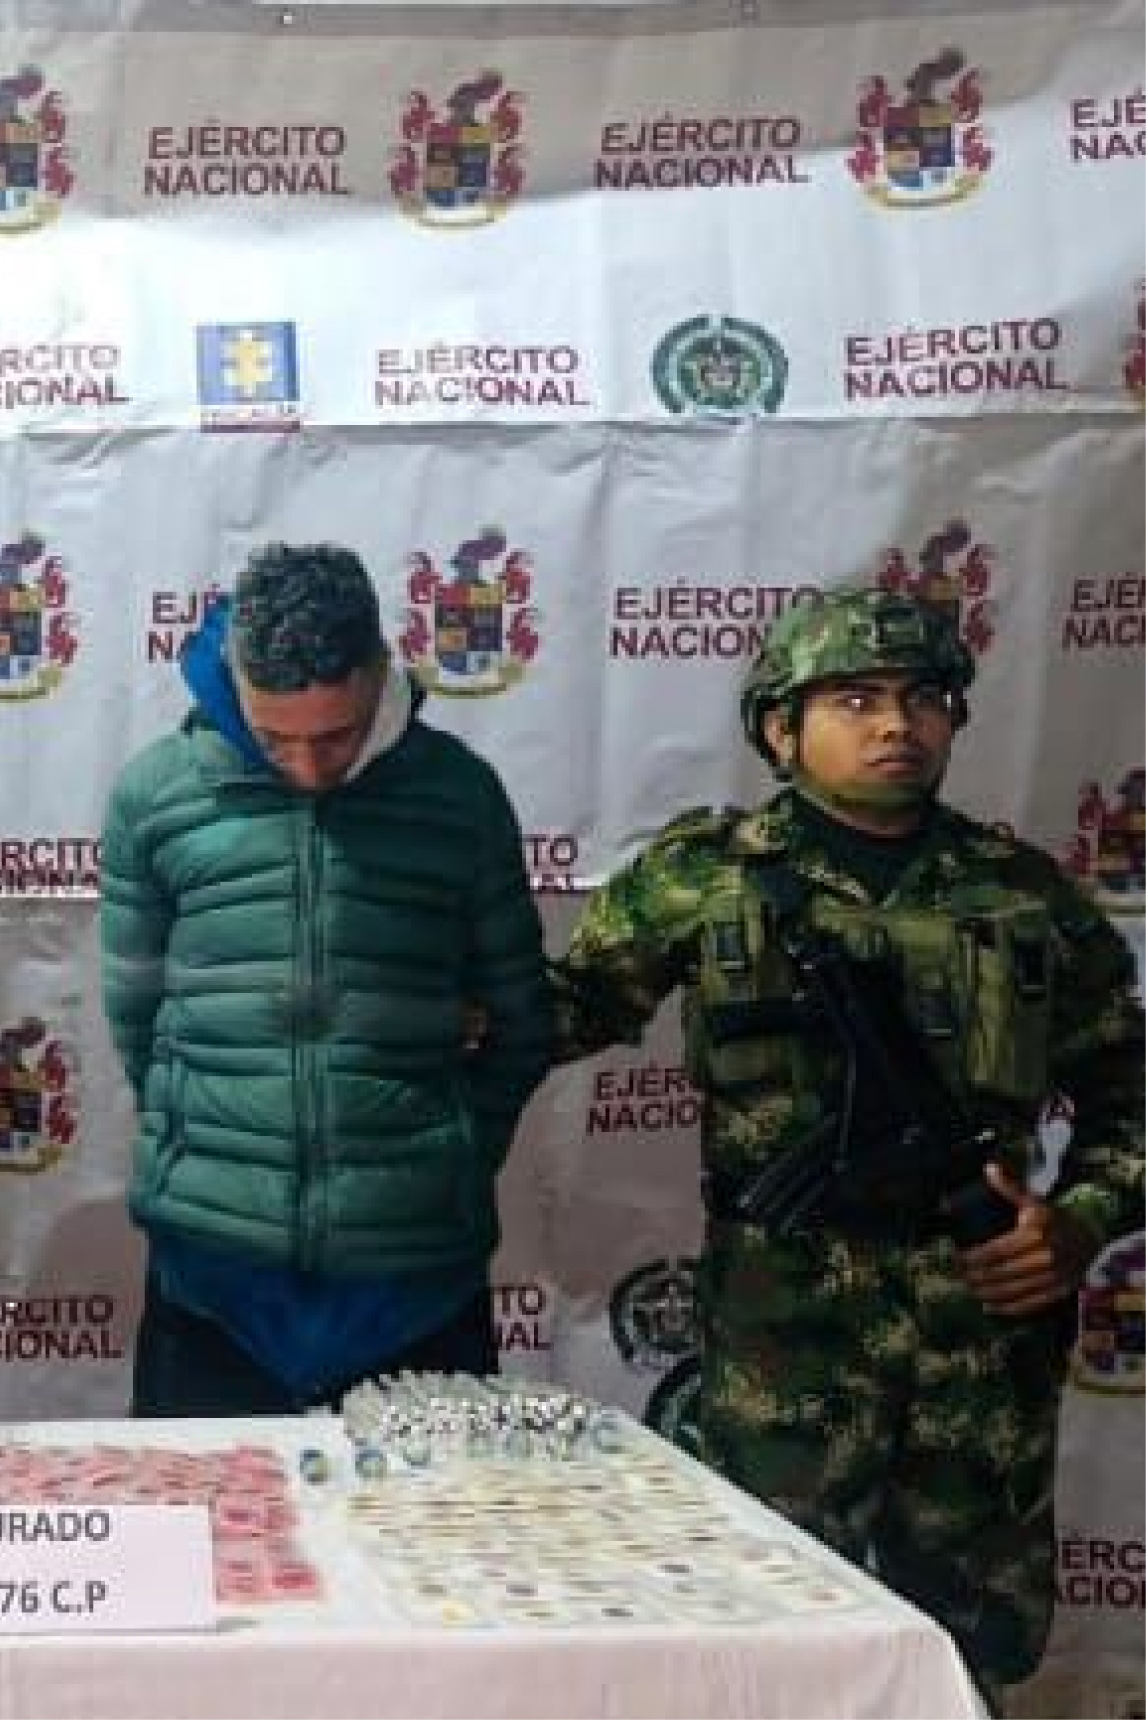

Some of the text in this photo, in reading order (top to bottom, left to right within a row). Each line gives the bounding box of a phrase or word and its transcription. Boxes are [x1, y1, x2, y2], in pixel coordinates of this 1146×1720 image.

[149, 117, 347, 158] EJÉRCITO
[601, 112, 801, 153] EJÉRCITO
[143, 161, 350, 196] NACIONAL
[594, 154, 810, 190] NACIONAL
[376, 341, 579, 374] EJÉRCITO
[845, 318, 1062, 367] EJÉRCITO
[374, 376, 591, 406] NACIONAL
[844, 357, 1069, 400] NACIONAL
[49, 1581, 107, 1615] C.P
